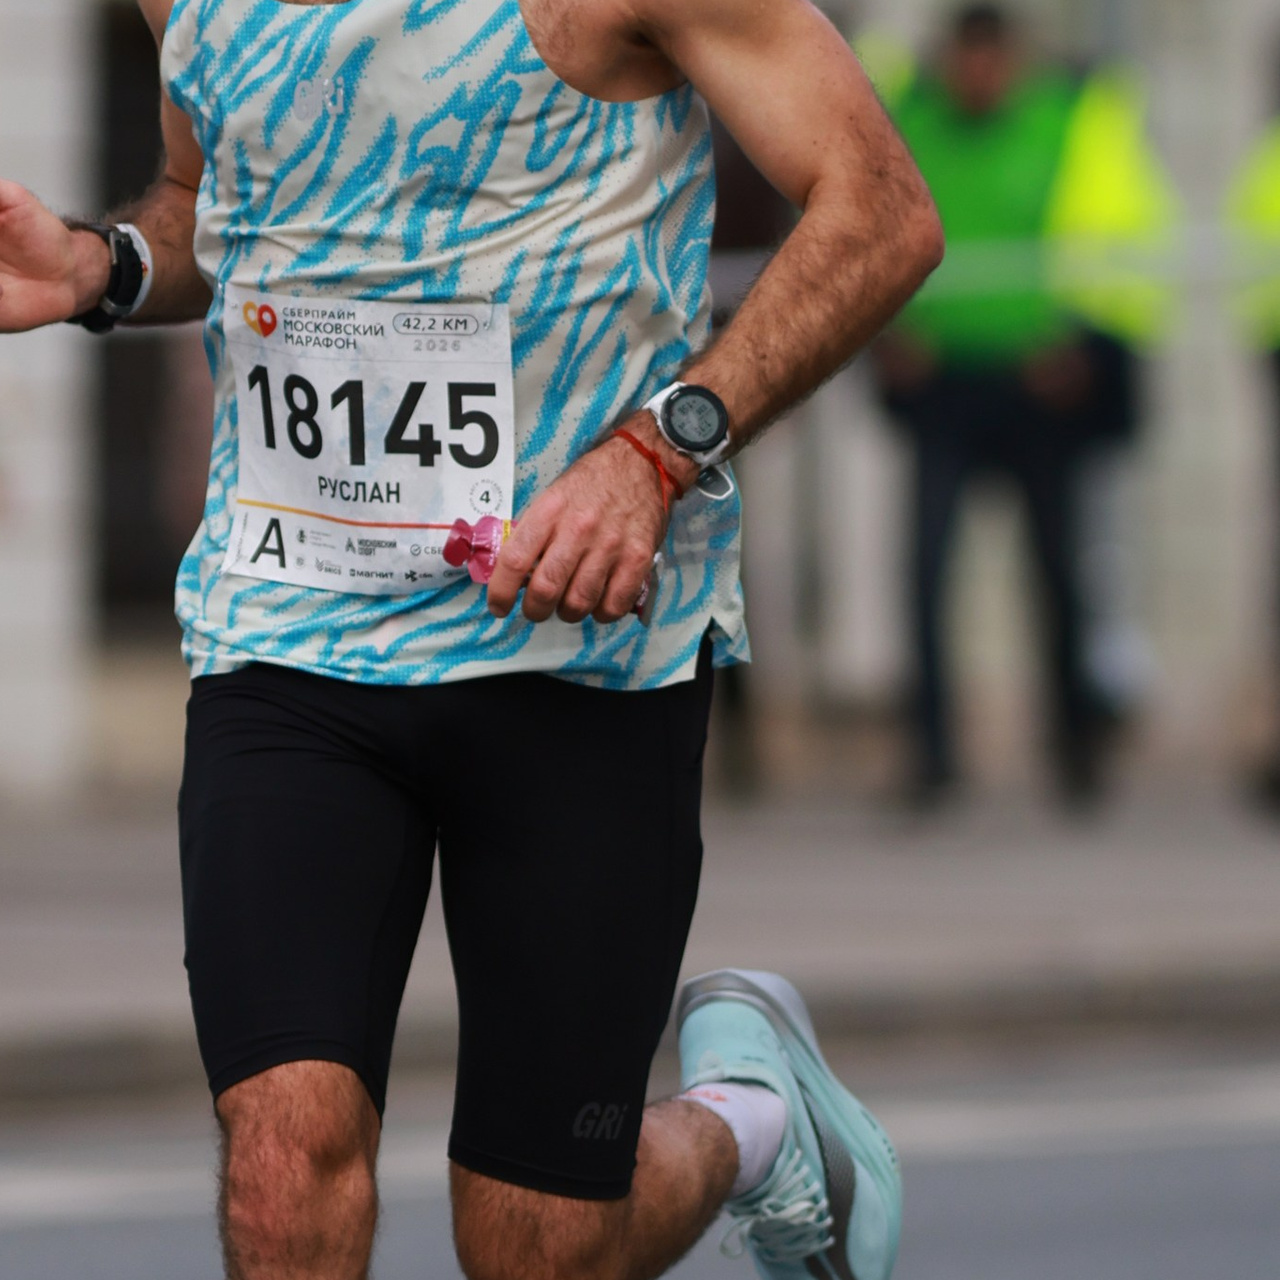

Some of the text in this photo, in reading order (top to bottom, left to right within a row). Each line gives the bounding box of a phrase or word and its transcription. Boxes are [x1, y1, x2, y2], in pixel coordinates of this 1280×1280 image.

[282, 306, 356, 321] СБЕРПРАЙМ
[283, 319, 385, 337] МОСКОВСКИЙ
[402, 317, 468, 332] 42,2 КМ
[285, 332, 357, 350] МАРАФОН
[247, 363, 500, 470] 18145
[318, 475, 401, 504] РУСЛАН
[479, 490, 491, 504] 4
[424, 546, 443, 555] СБЕ
[572, 1101, 628, 1141] GRi
